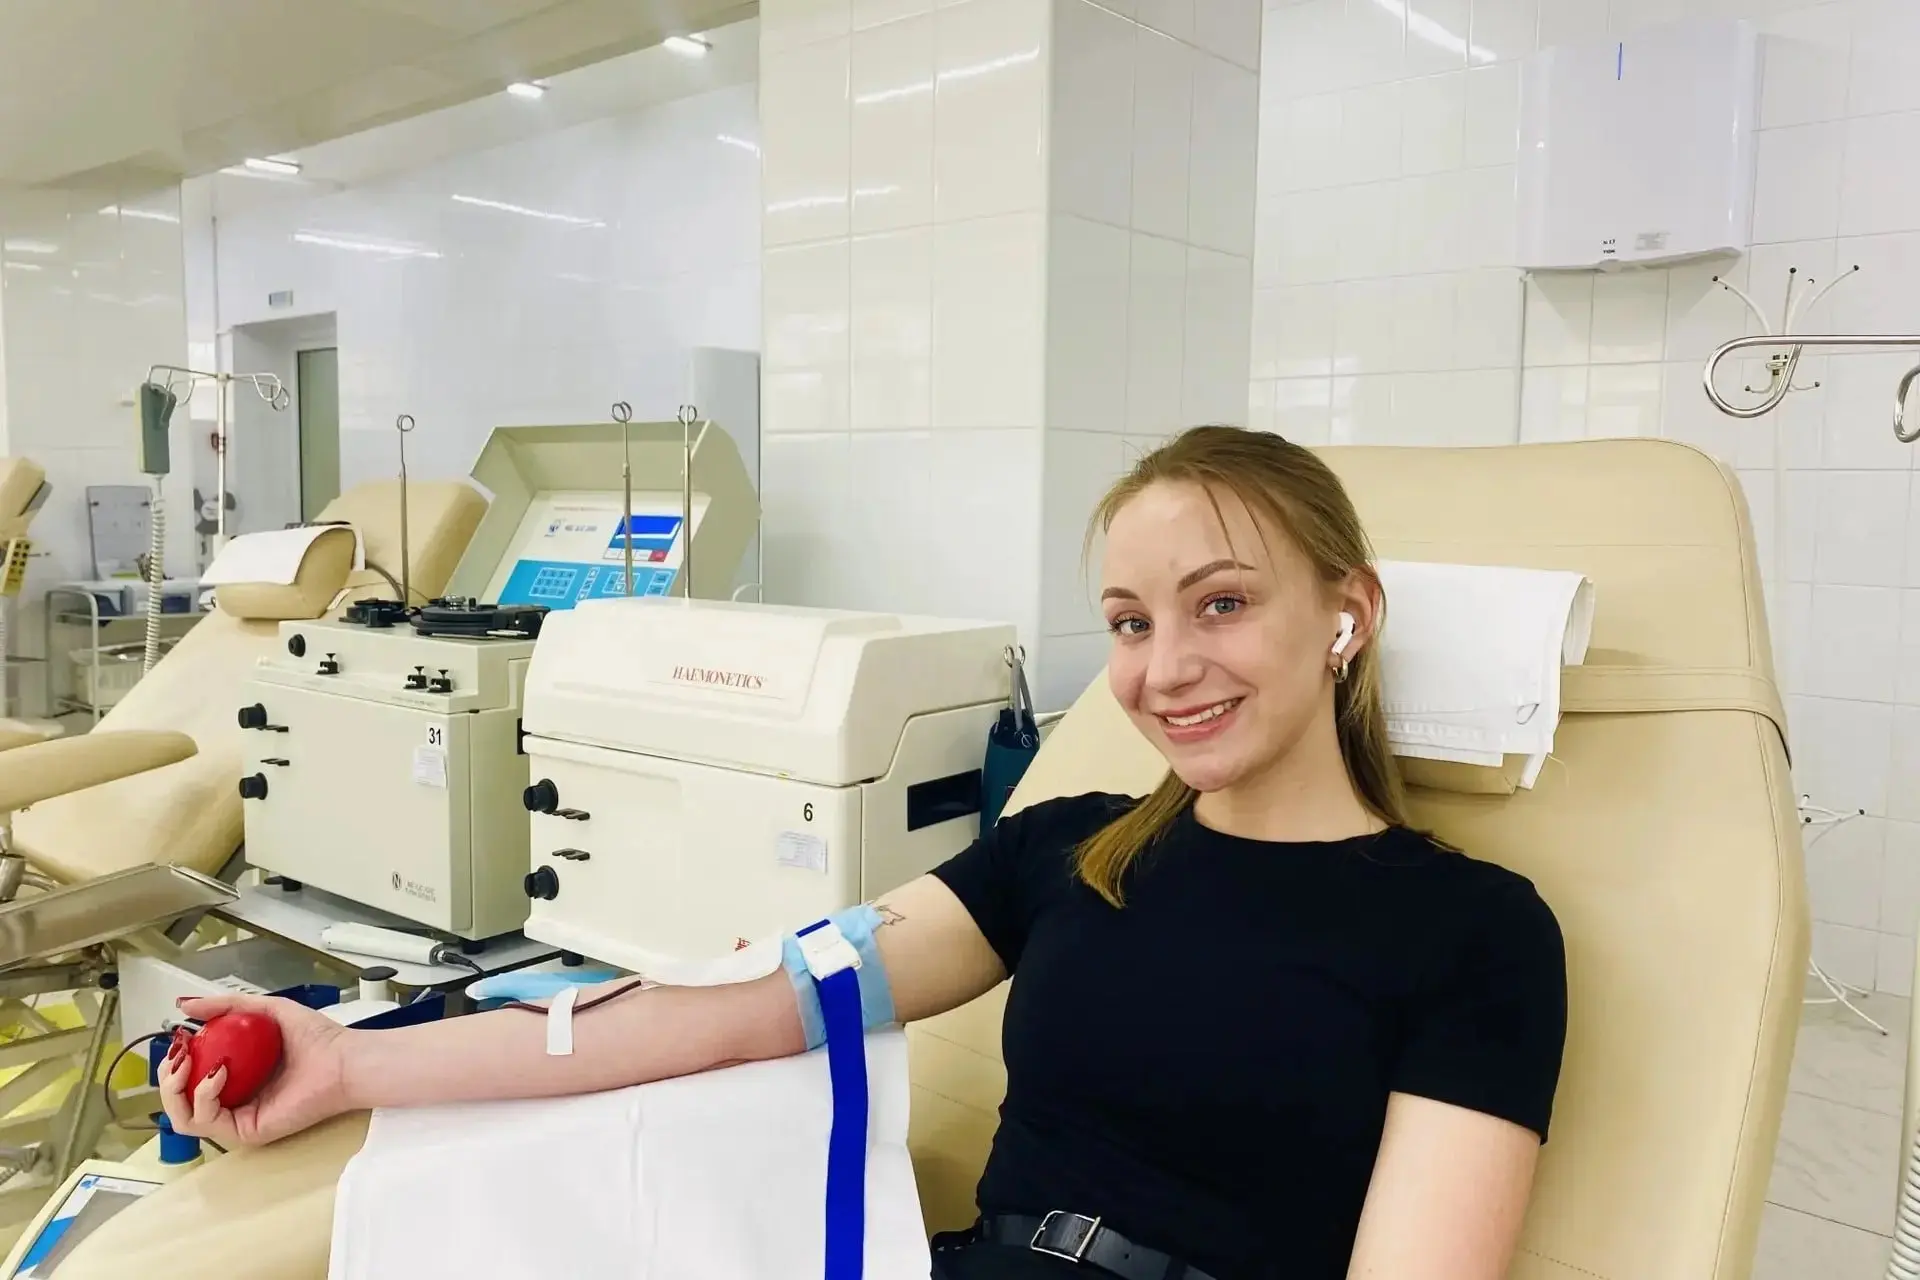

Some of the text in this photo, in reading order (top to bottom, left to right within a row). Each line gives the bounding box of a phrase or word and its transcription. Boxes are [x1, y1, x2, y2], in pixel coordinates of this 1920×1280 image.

[672, 665, 763, 689] HAEMONETICS
[428, 727, 442, 746] 31
[803, 802, 814, 822] 6
